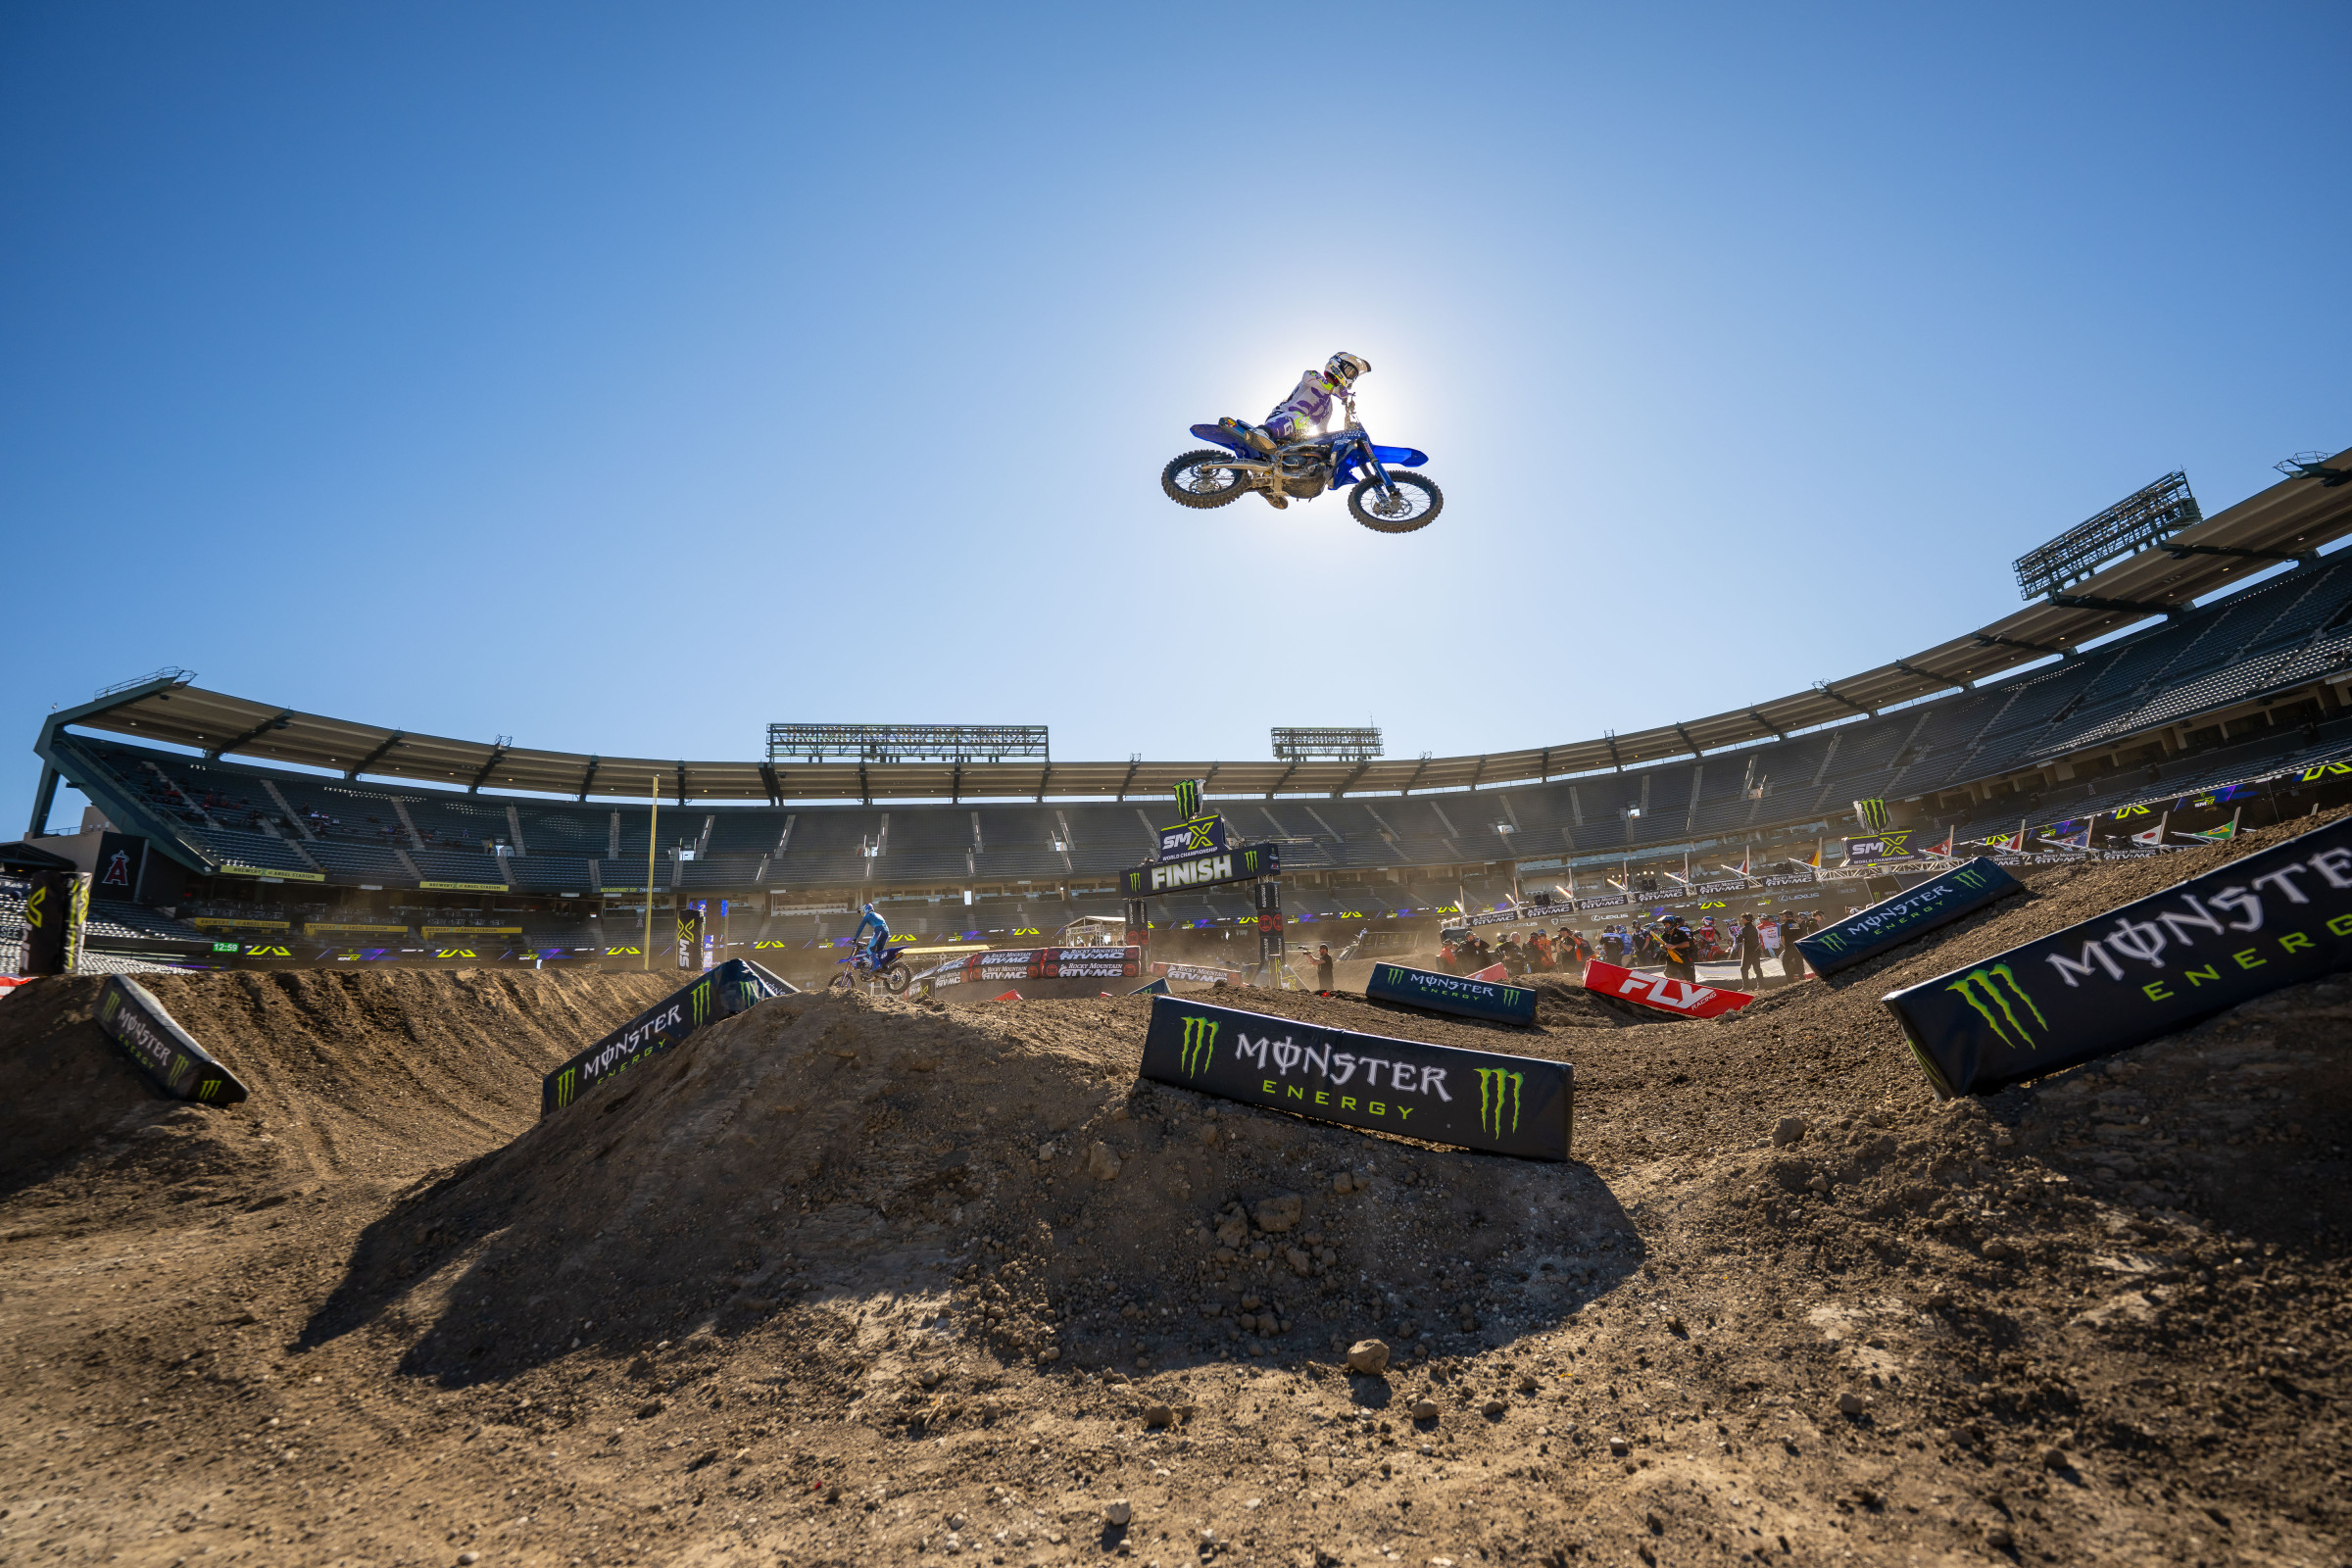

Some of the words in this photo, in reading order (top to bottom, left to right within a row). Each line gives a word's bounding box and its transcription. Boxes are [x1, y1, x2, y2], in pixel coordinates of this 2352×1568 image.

[1162, 821, 1214, 851] SMX
[1851, 835, 1910, 858] SMX
[1162, 854, 1180, 862] WORLD
[1180, 846, 1218, 859] CHAMPIONSHIP
[1873, 855, 1915, 863] CHAMPIONSHIP
[1151, 855, 1233, 891] FINISH
[1874, 900, 1944, 935] ENERGY
[214, 943, 238, 952] 12:59
[677, 917, 695, 969] SMX
[1198, 968, 1228, 978] MOUNTAIN
[1421, 986, 1480, 1001] ENERGY
[1618, 970, 1715, 1009] FLY
[1690, 992, 1717, 1011] RACING
[118, 1033, 155, 1070] ENERGY
[1261, 1079, 1416, 1121] ENERGY
